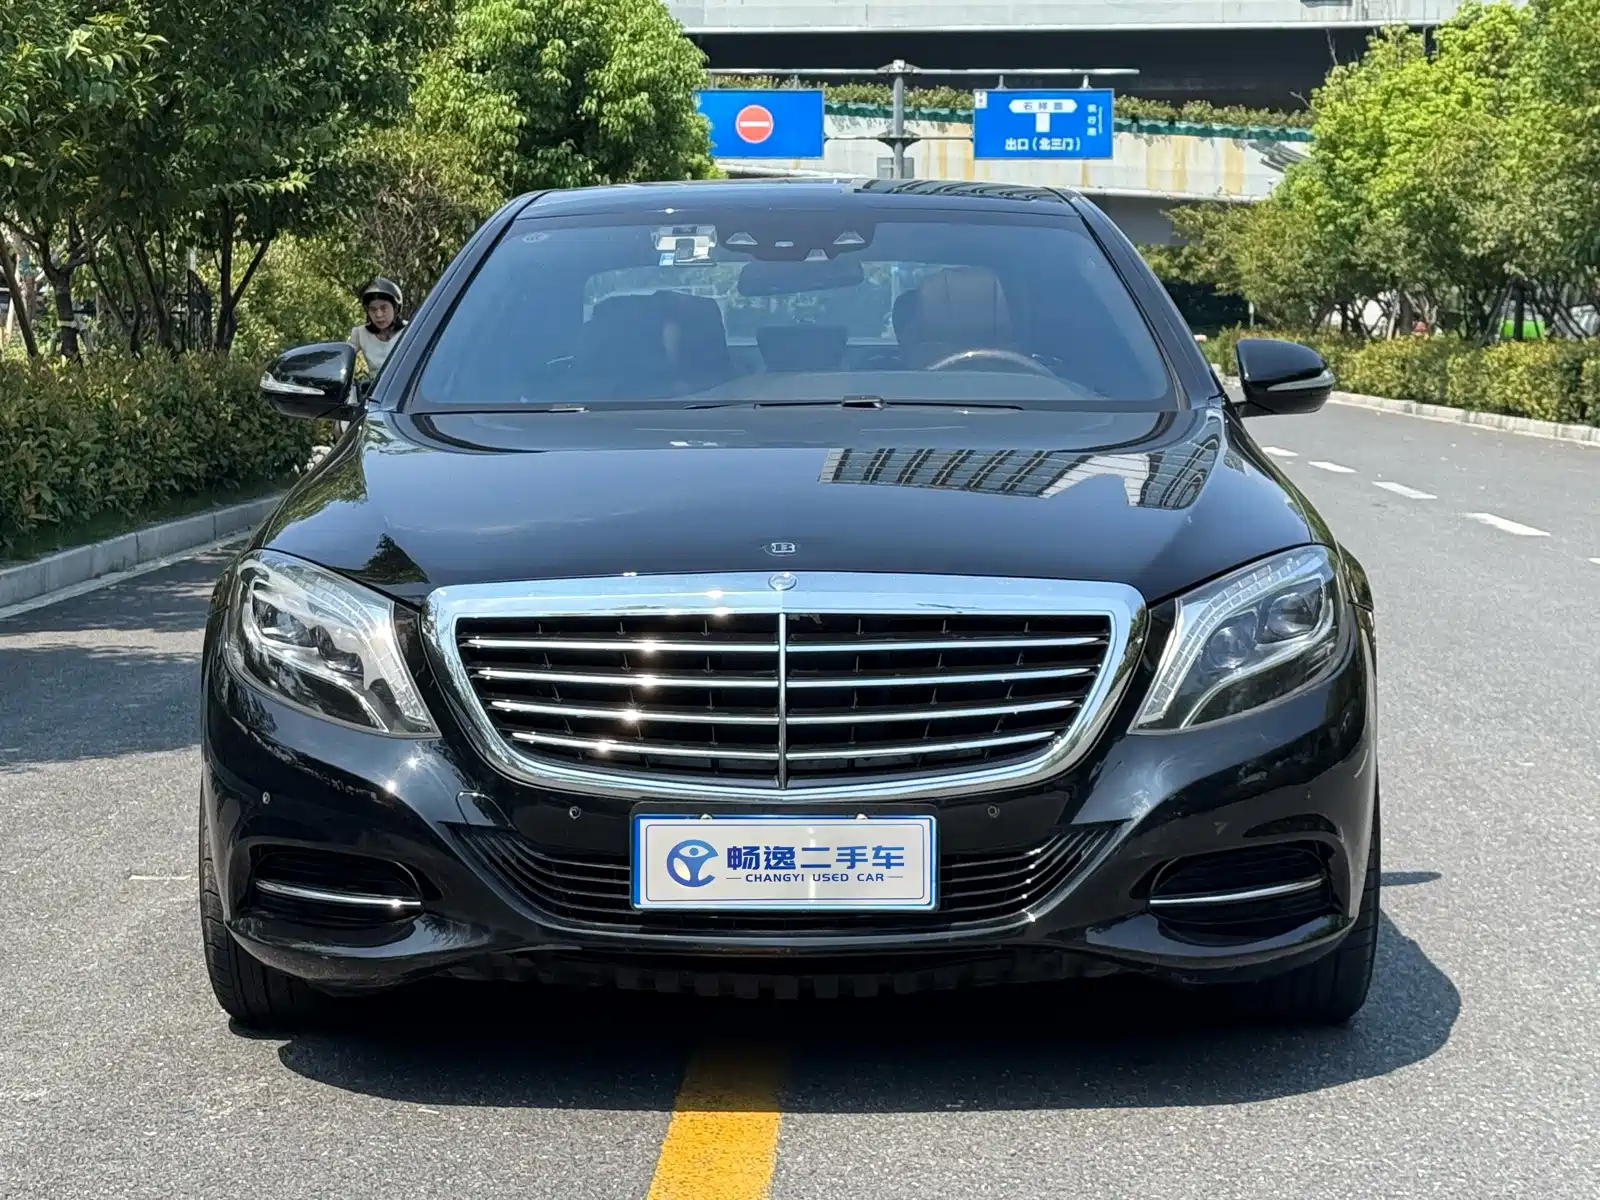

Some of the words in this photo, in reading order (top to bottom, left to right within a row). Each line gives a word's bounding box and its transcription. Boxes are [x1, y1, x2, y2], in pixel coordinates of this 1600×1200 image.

[726, 845, 905, 871] 畅逸二手车
[745, 873, 805, 883] CHANGYI
[812, 873, 849, 882] USED
[857, 873, 885, 882] CAR
